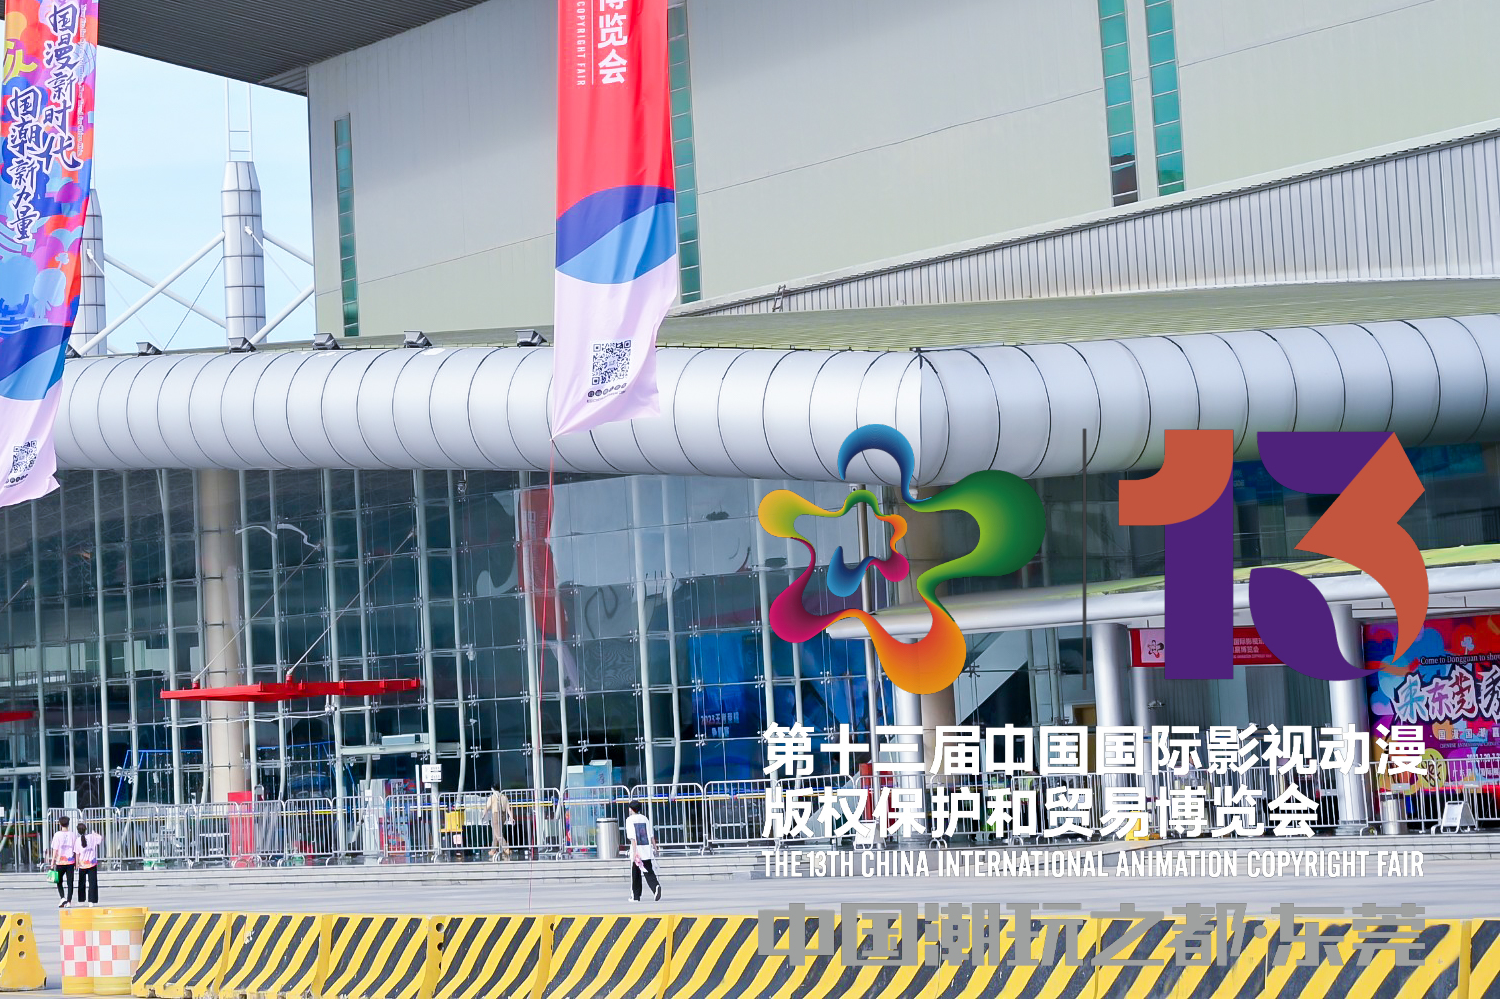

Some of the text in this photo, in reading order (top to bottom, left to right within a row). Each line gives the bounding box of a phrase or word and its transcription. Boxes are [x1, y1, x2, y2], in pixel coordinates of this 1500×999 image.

[576, 2, 586, 59] COPYRIGHT
[28, 3, 82, 169] 国漫新时代
[576, 63, 586, 86] FAIR
[9, 87, 40, 241] 国潮新力量
[1420, 656, 1439, 665] Come
[1439, 656, 1446, 664] to
[1446, 655, 1478, 665] Dongguan
